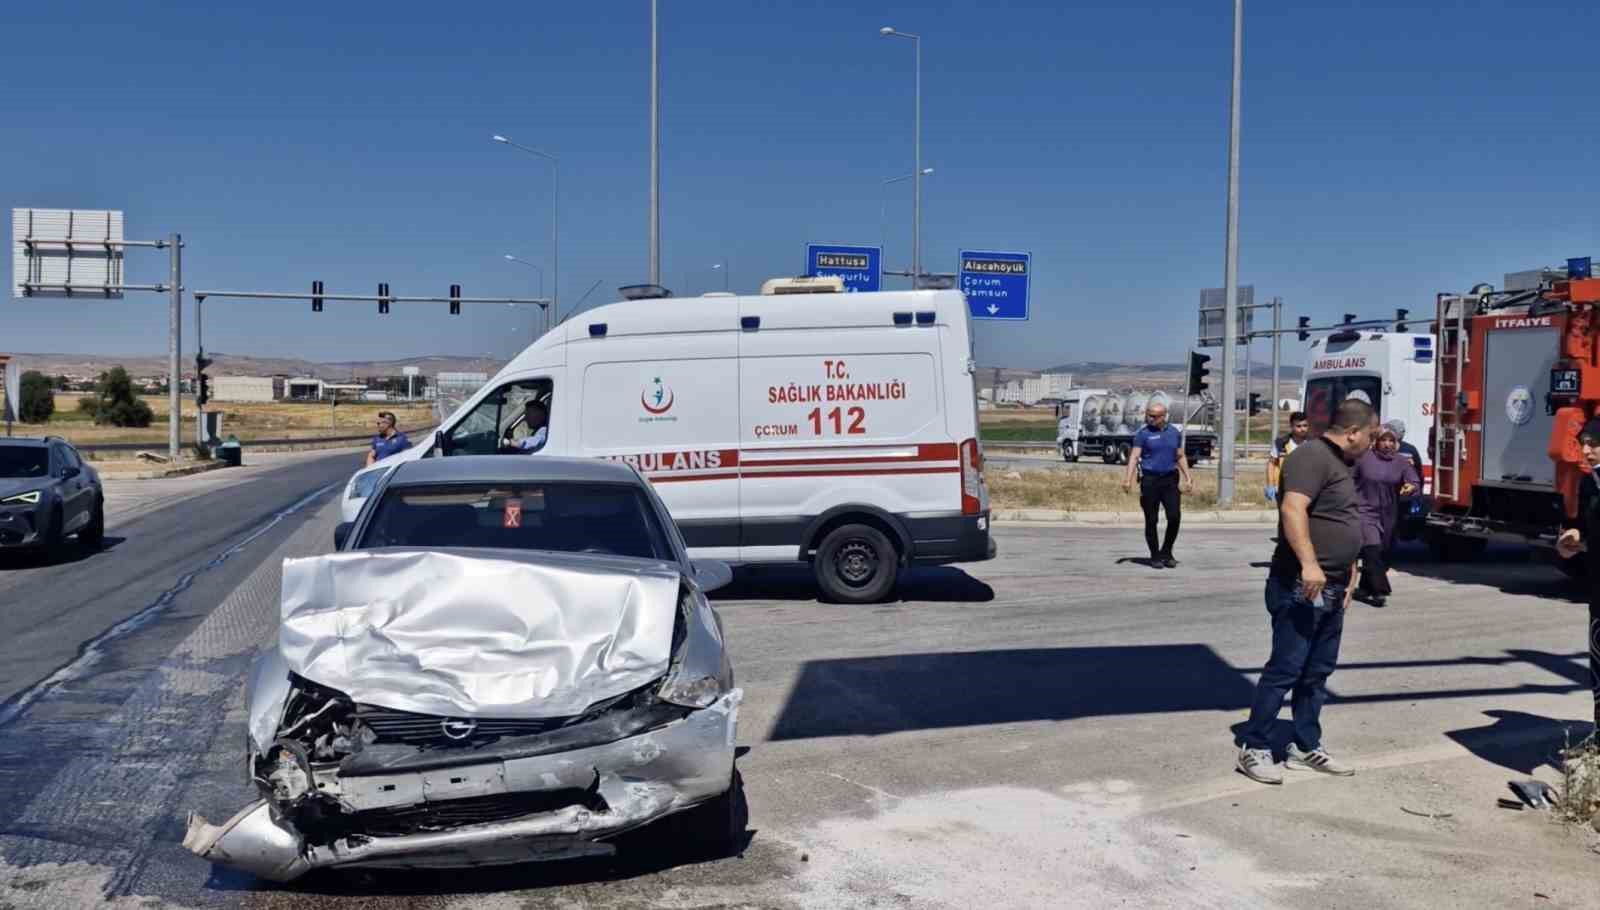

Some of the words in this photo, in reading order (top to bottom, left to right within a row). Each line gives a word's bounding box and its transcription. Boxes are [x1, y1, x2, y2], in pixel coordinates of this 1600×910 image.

[963, 287, 1008, 297] Samsun
[824, 360, 850, 379] T.C.
[1313, 357, 1367, 369] AMBULANS
[768, 382, 821, 404] SAĞLIK
[826, 378, 906, 402] BAKANLIĞI
[807, 406, 866, 435] 112
[605, 451, 721, 472] BULANS
